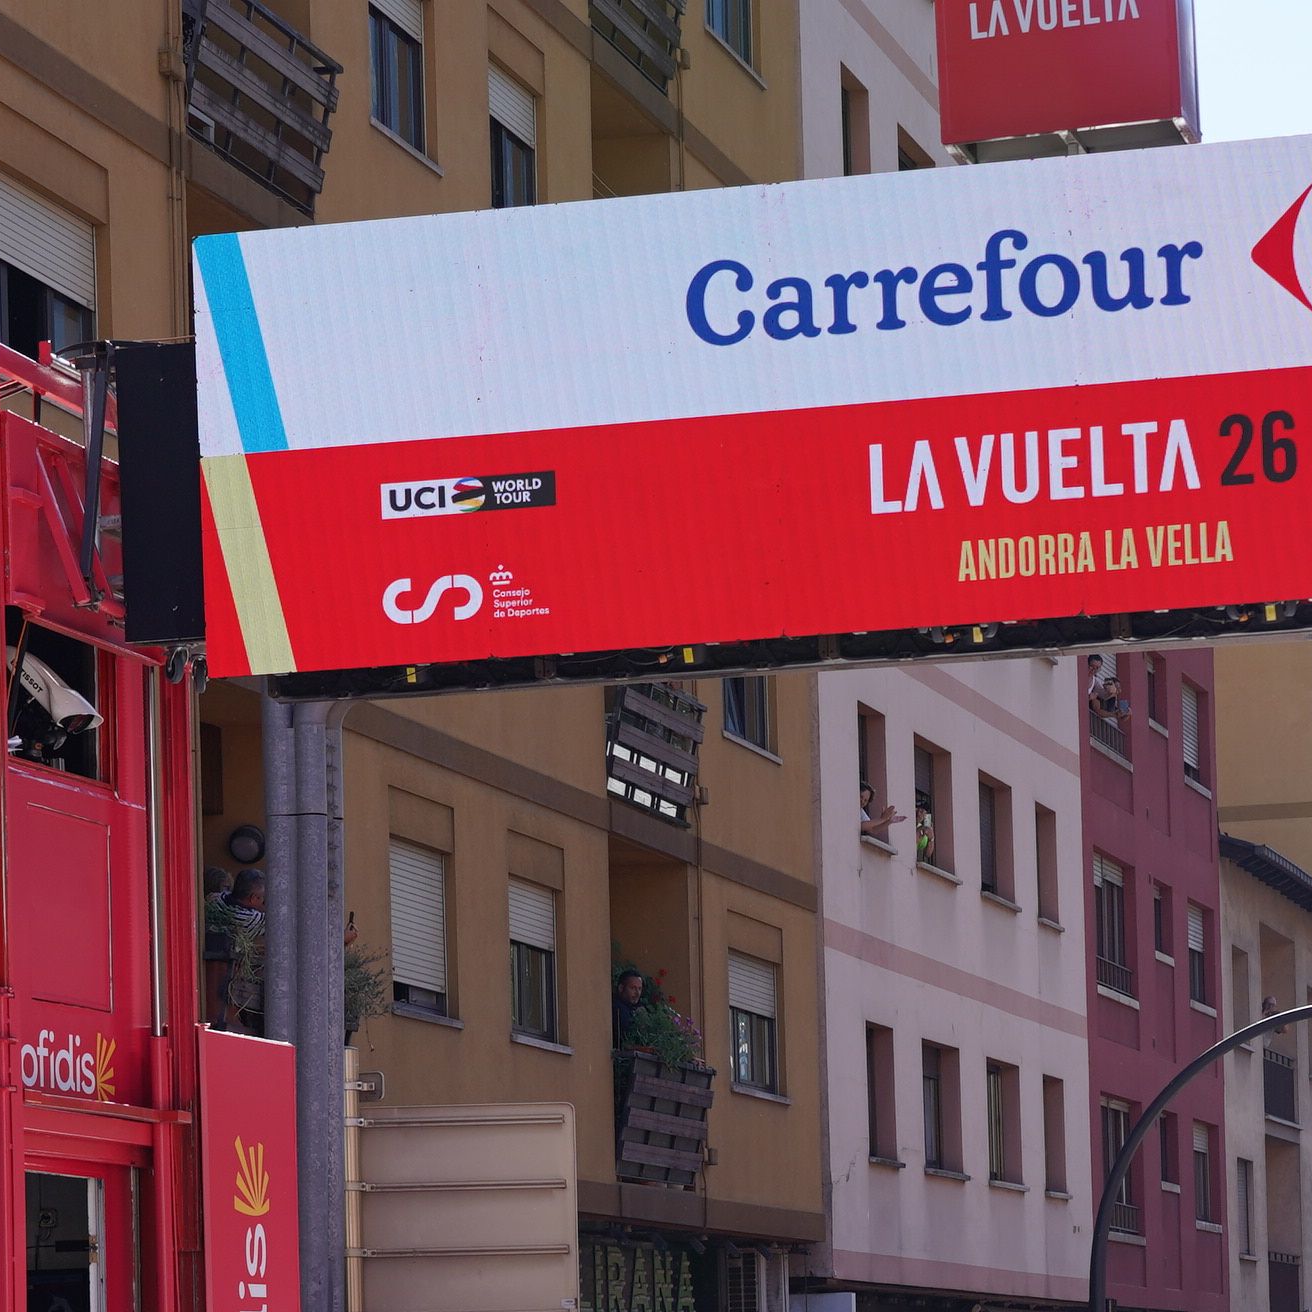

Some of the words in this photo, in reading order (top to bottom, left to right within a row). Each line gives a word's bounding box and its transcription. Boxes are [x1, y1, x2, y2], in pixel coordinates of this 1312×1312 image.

[969, 3, 1010, 39] LA
[687, 230, 1202, 345] Carrefour
[871, 440, 944, 514] LA
[954, 420, 1199, 505] VUELTA
[1219, 410, 1297, 487] 26
[492, 478, 542, 492] WORLD
[495, 492, 531, 504] TOUR
[390, 486, 445, 512] UCI
[957, 530, 1095, 582] ANDORRA
[1104, 527, 1141, 571] LA
[1145, 520, 1234, 567] VELLA
[493, 588, 530, 602] Consejo
[494, 599, 533, 612] Superior
[494, 609, 506, 618] de
[508, 606, 550, 617] Deportes
[21, 1030, 96, 1095] ofidis
